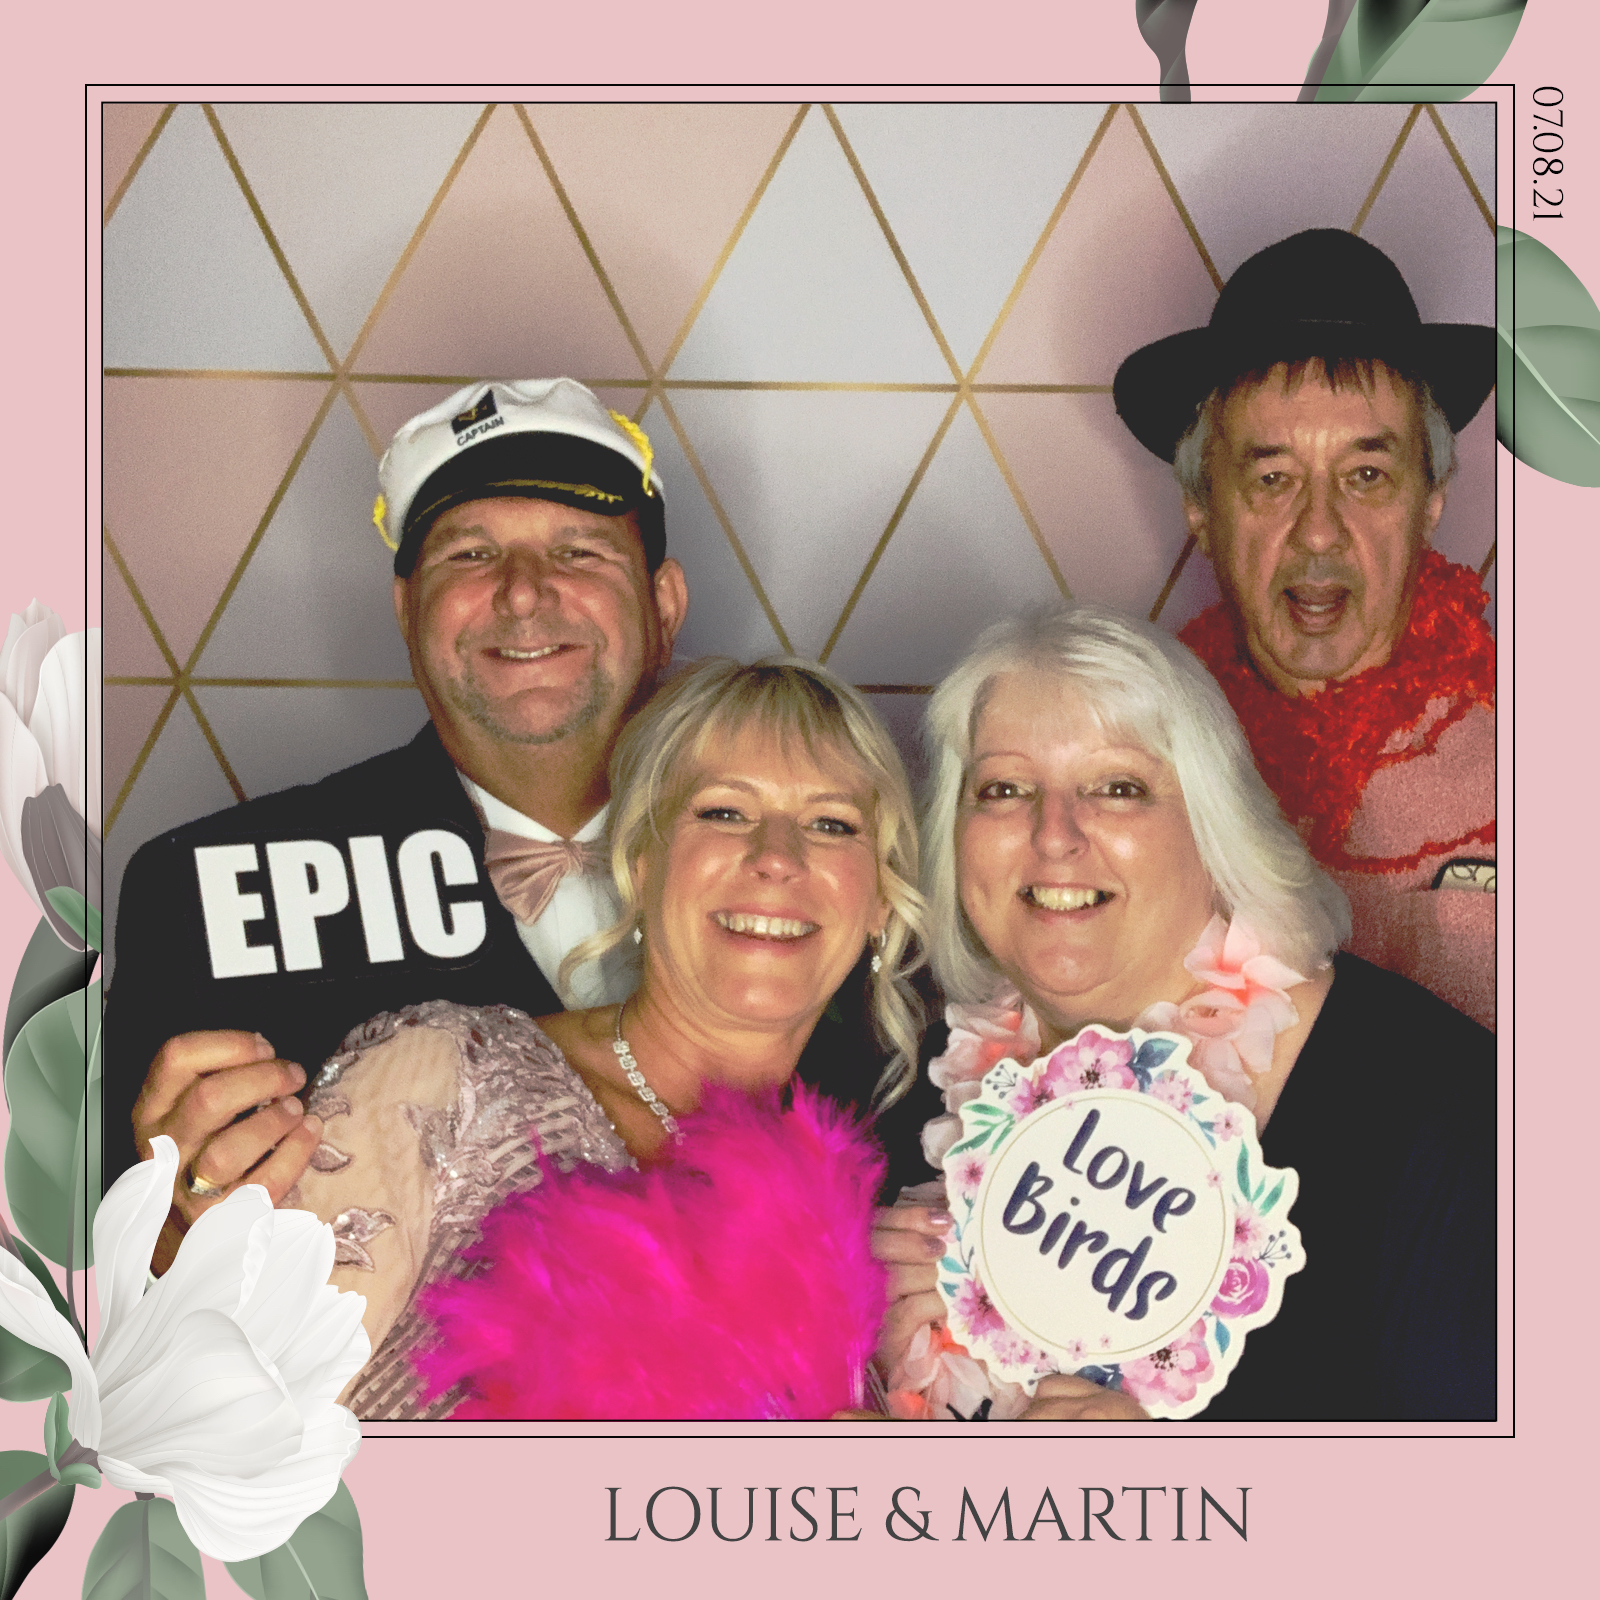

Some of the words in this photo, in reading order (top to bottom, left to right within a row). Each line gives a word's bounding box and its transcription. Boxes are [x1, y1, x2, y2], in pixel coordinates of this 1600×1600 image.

[456, 416, 505, 447] CAPTAIN
[194, 829, 487, 979] EPIC
[1063, 1108, 1196, 1234] Love
[1002, 1161, 1178, 1320] Birds
